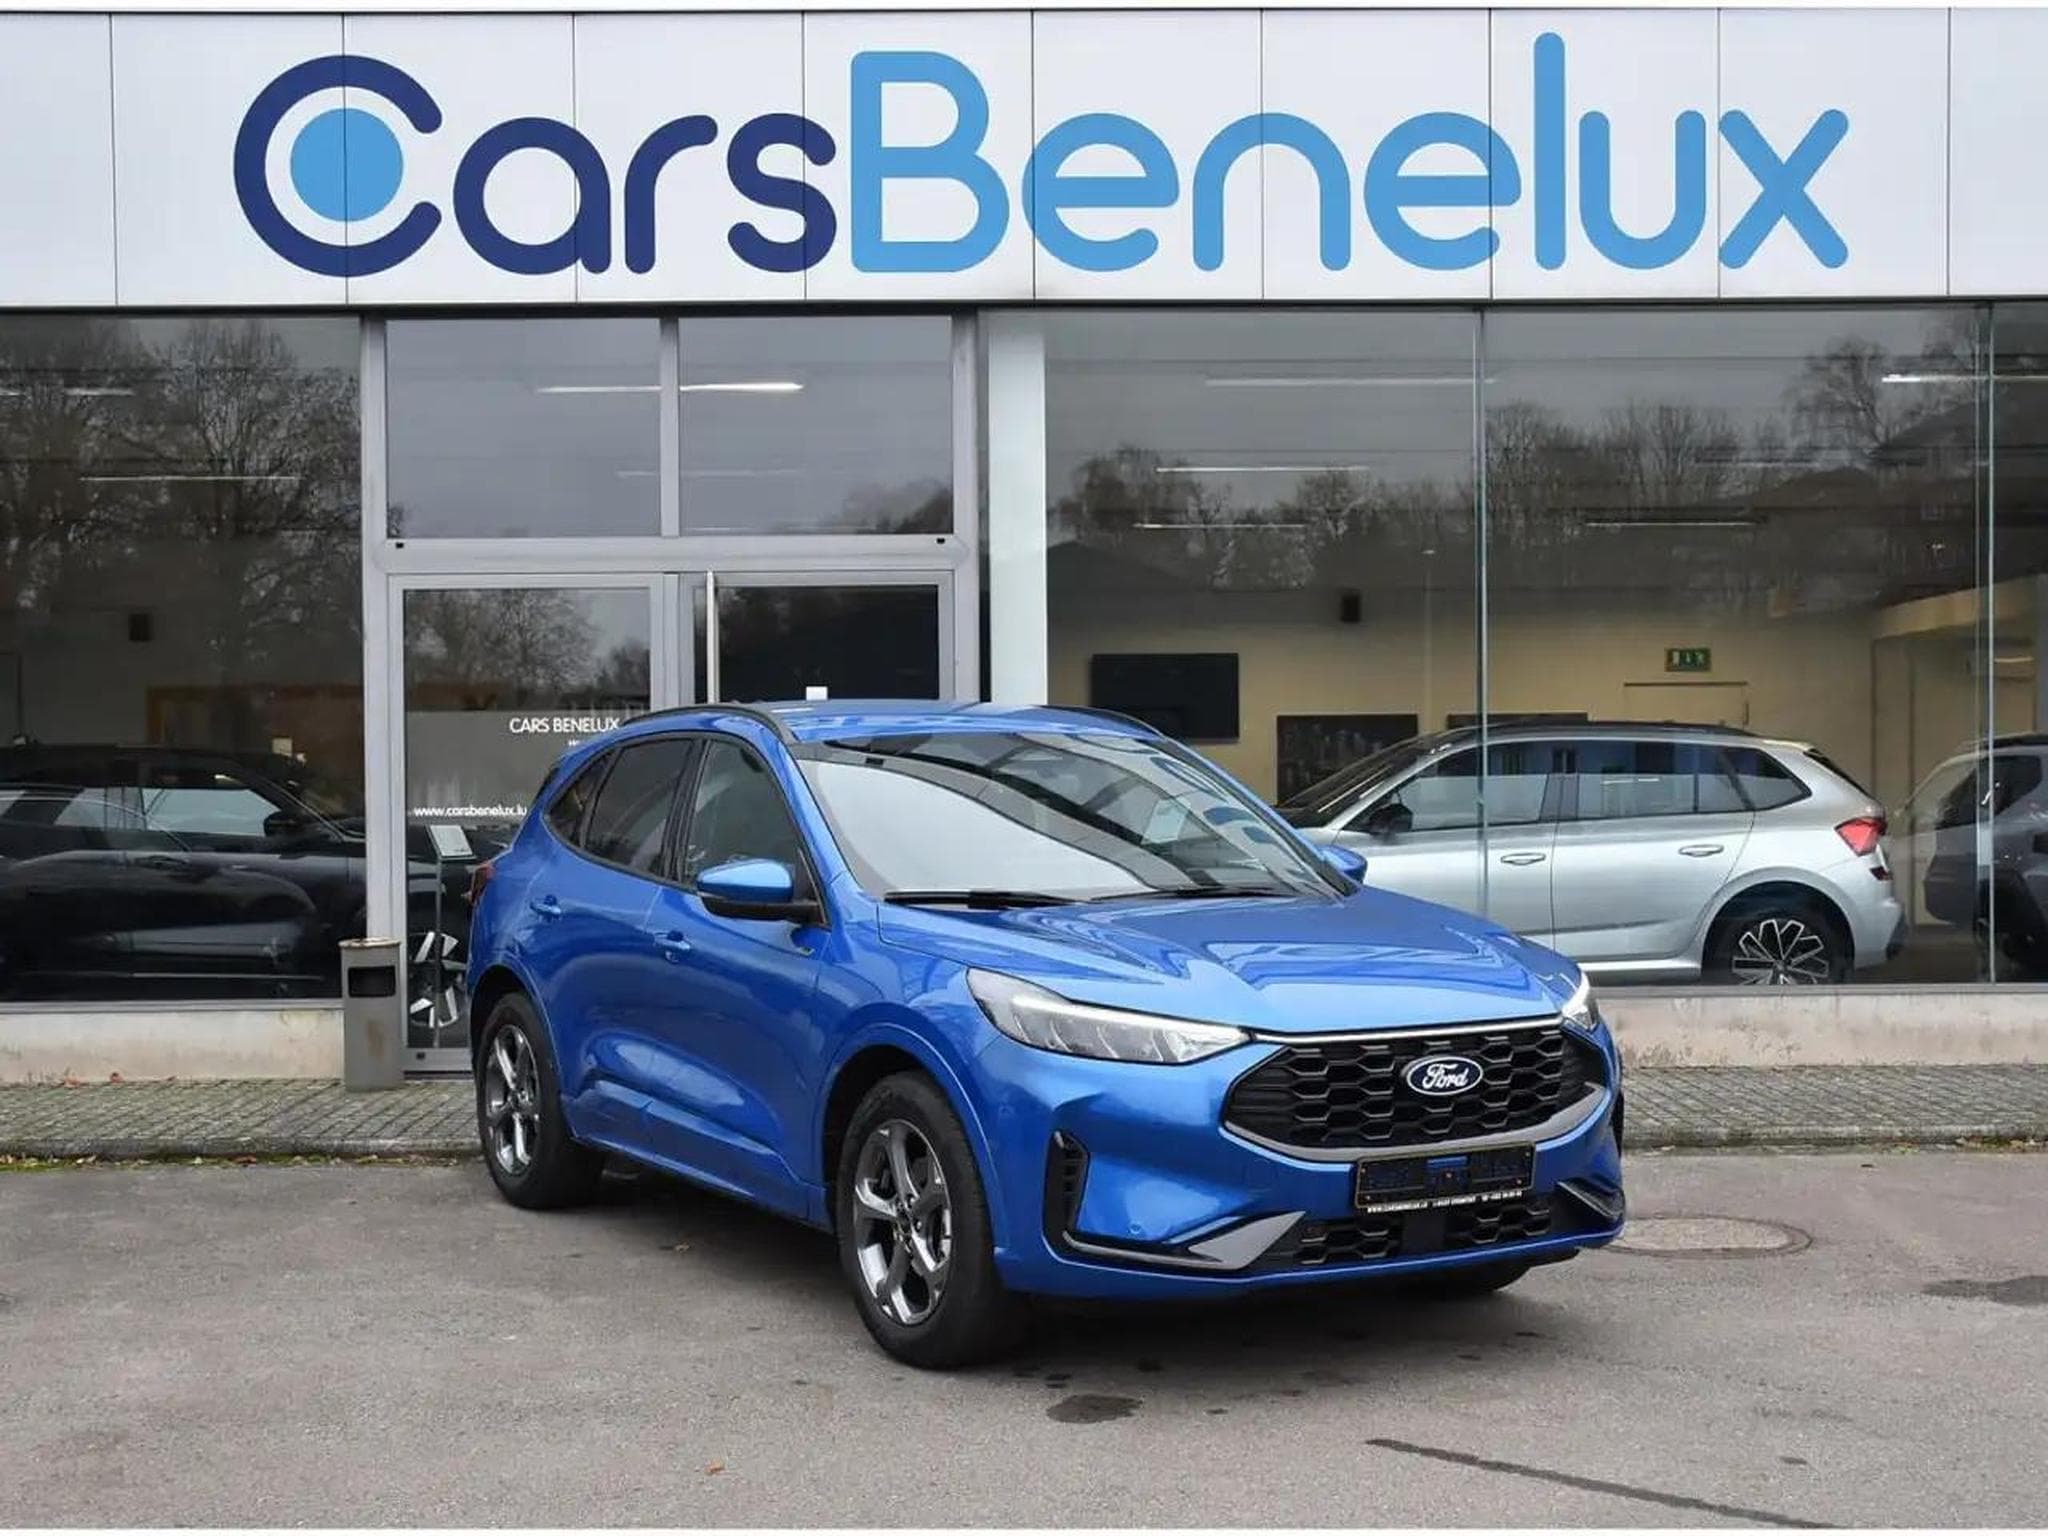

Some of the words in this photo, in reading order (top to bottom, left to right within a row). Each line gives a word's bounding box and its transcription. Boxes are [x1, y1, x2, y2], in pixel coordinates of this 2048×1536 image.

[509, 716, 550, 733] CARS
[552, 716, 620, 733] BENELUX
[413, 804, 527, 817] www.carsbenelux.lu
[1421, 1063, 1469, 1089] Ford
